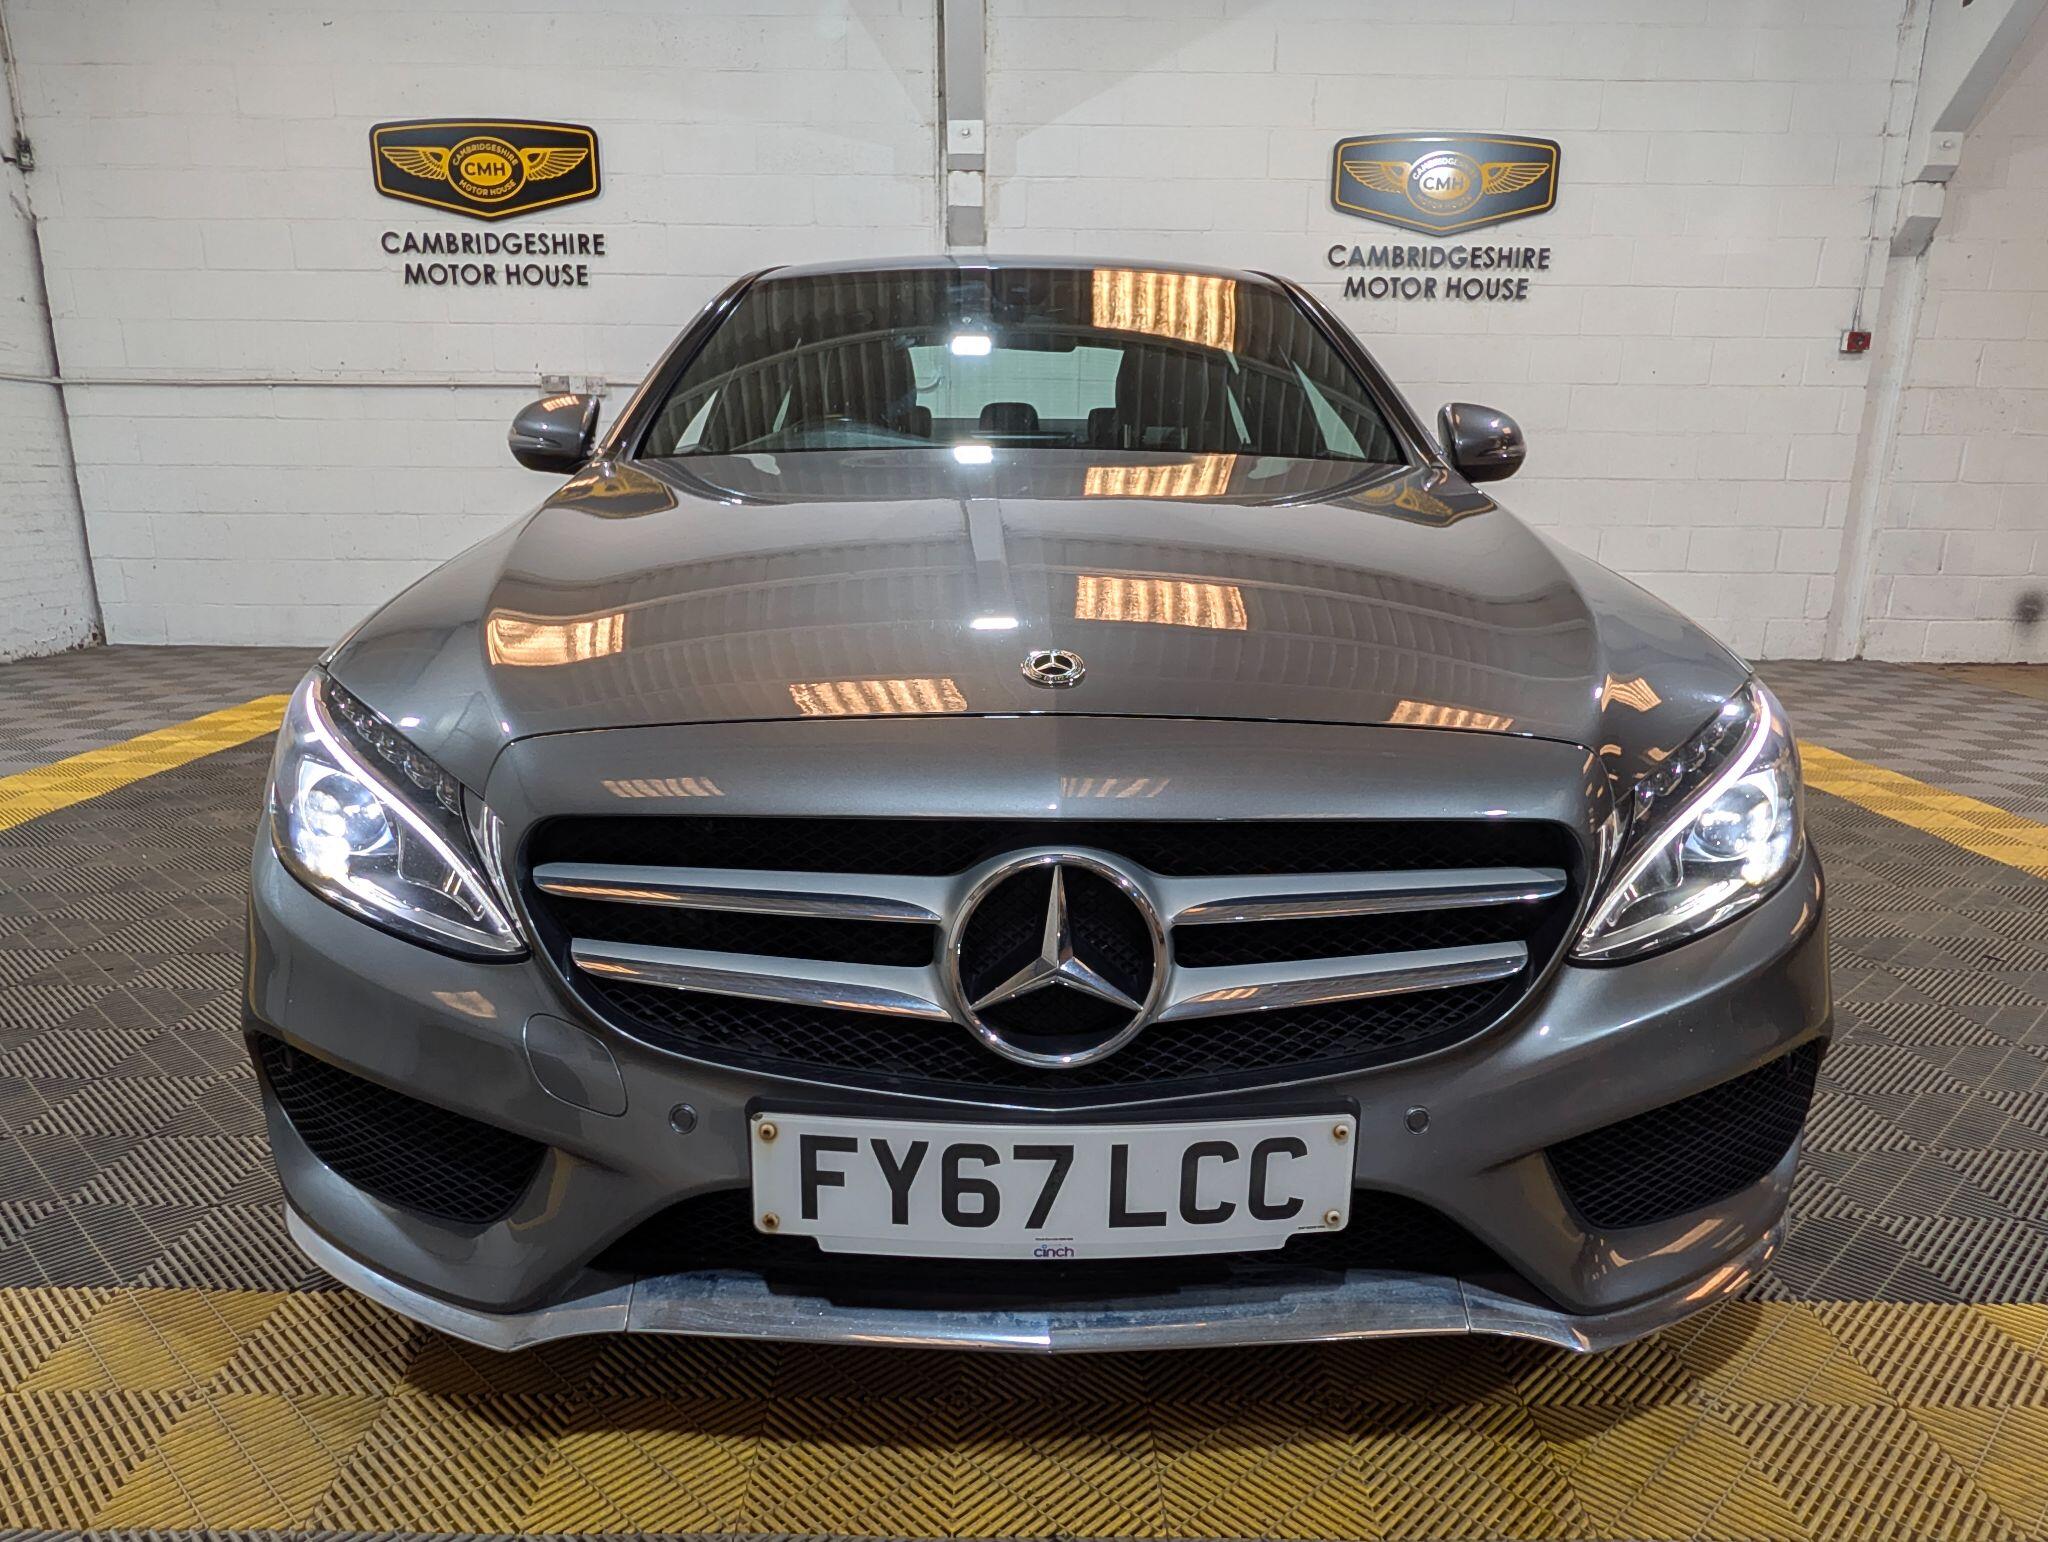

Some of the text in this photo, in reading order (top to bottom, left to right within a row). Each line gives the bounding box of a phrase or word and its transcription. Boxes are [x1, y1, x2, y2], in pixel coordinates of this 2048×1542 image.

[453, 143, 519, 166] CAMBRIDGESHIRE
[464, 162, 506, 177] CMH
[459, 179, 517, 196] MOTOR HOUSE
[1423, 177, 1464, 191] CMH
[381, 231, 606, 256] CAMBRIDGESHIRE
[1328, 244, 1551, 270] CAMBRIDGESHIRE
[404, 263, 589, 287] MOTOR HOUSE
[1344, 276, 1530, 300] MOTOR HOUSE
[799, 1133, 1309, 1230] FY67 LCC
[1033, 1244, 1075, 1258] cinch
